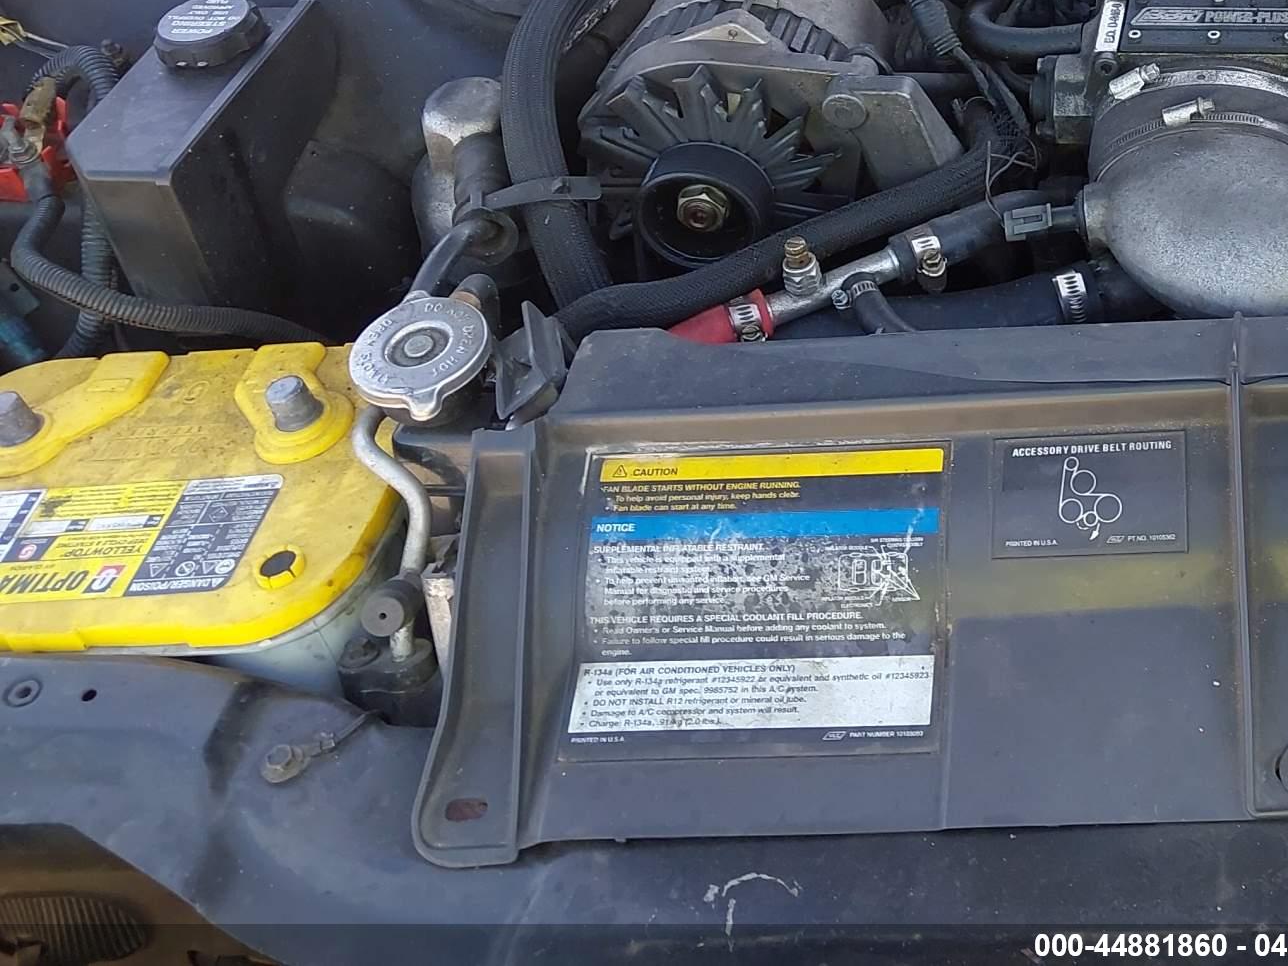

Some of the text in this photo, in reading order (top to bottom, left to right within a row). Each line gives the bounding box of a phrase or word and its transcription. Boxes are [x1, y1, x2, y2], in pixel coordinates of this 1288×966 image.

[424, 303, 443, 312] DO
[1013, 441, 1172, 457] ACCESSORY DRIVE BELT ROUTING
[633, 468, 678, 476] CAUTION
[626, 494, 643, 503] help
[668, 493, 703, 502] personal
[731, 492, 750, 500] keep
[597, 524, 635, 532] NOTICE
[0, 570, 89, 595] OPTIMA
[130, 578, 212, 591] DANGER/POISON
[743, 614, 784, 622] COOLANT
[807, 612, 863, 620] PROCEDURE.
[669, 636, 698, 645] special
[712, 636, 754, 644] procedure
[846, 633, 880, 641] damage
[615, 667, 637, 677] (FOR
[658, 666, 720, 675] CONDITIONED
[769, 664, 795, 673] ONLY)
[665, 677, 708, 686] refrigerant
[769, 676, 812, 684] equivalent
[832, 674, 868, 682] synthetic
[606, 688, 649, 698] equivalent
[685, 697, 728, 706] refrigerant
[590, 710, 625, 718] Damage
[657, 709, 706, 718] compressor
[726, 708, 756, 716] system
